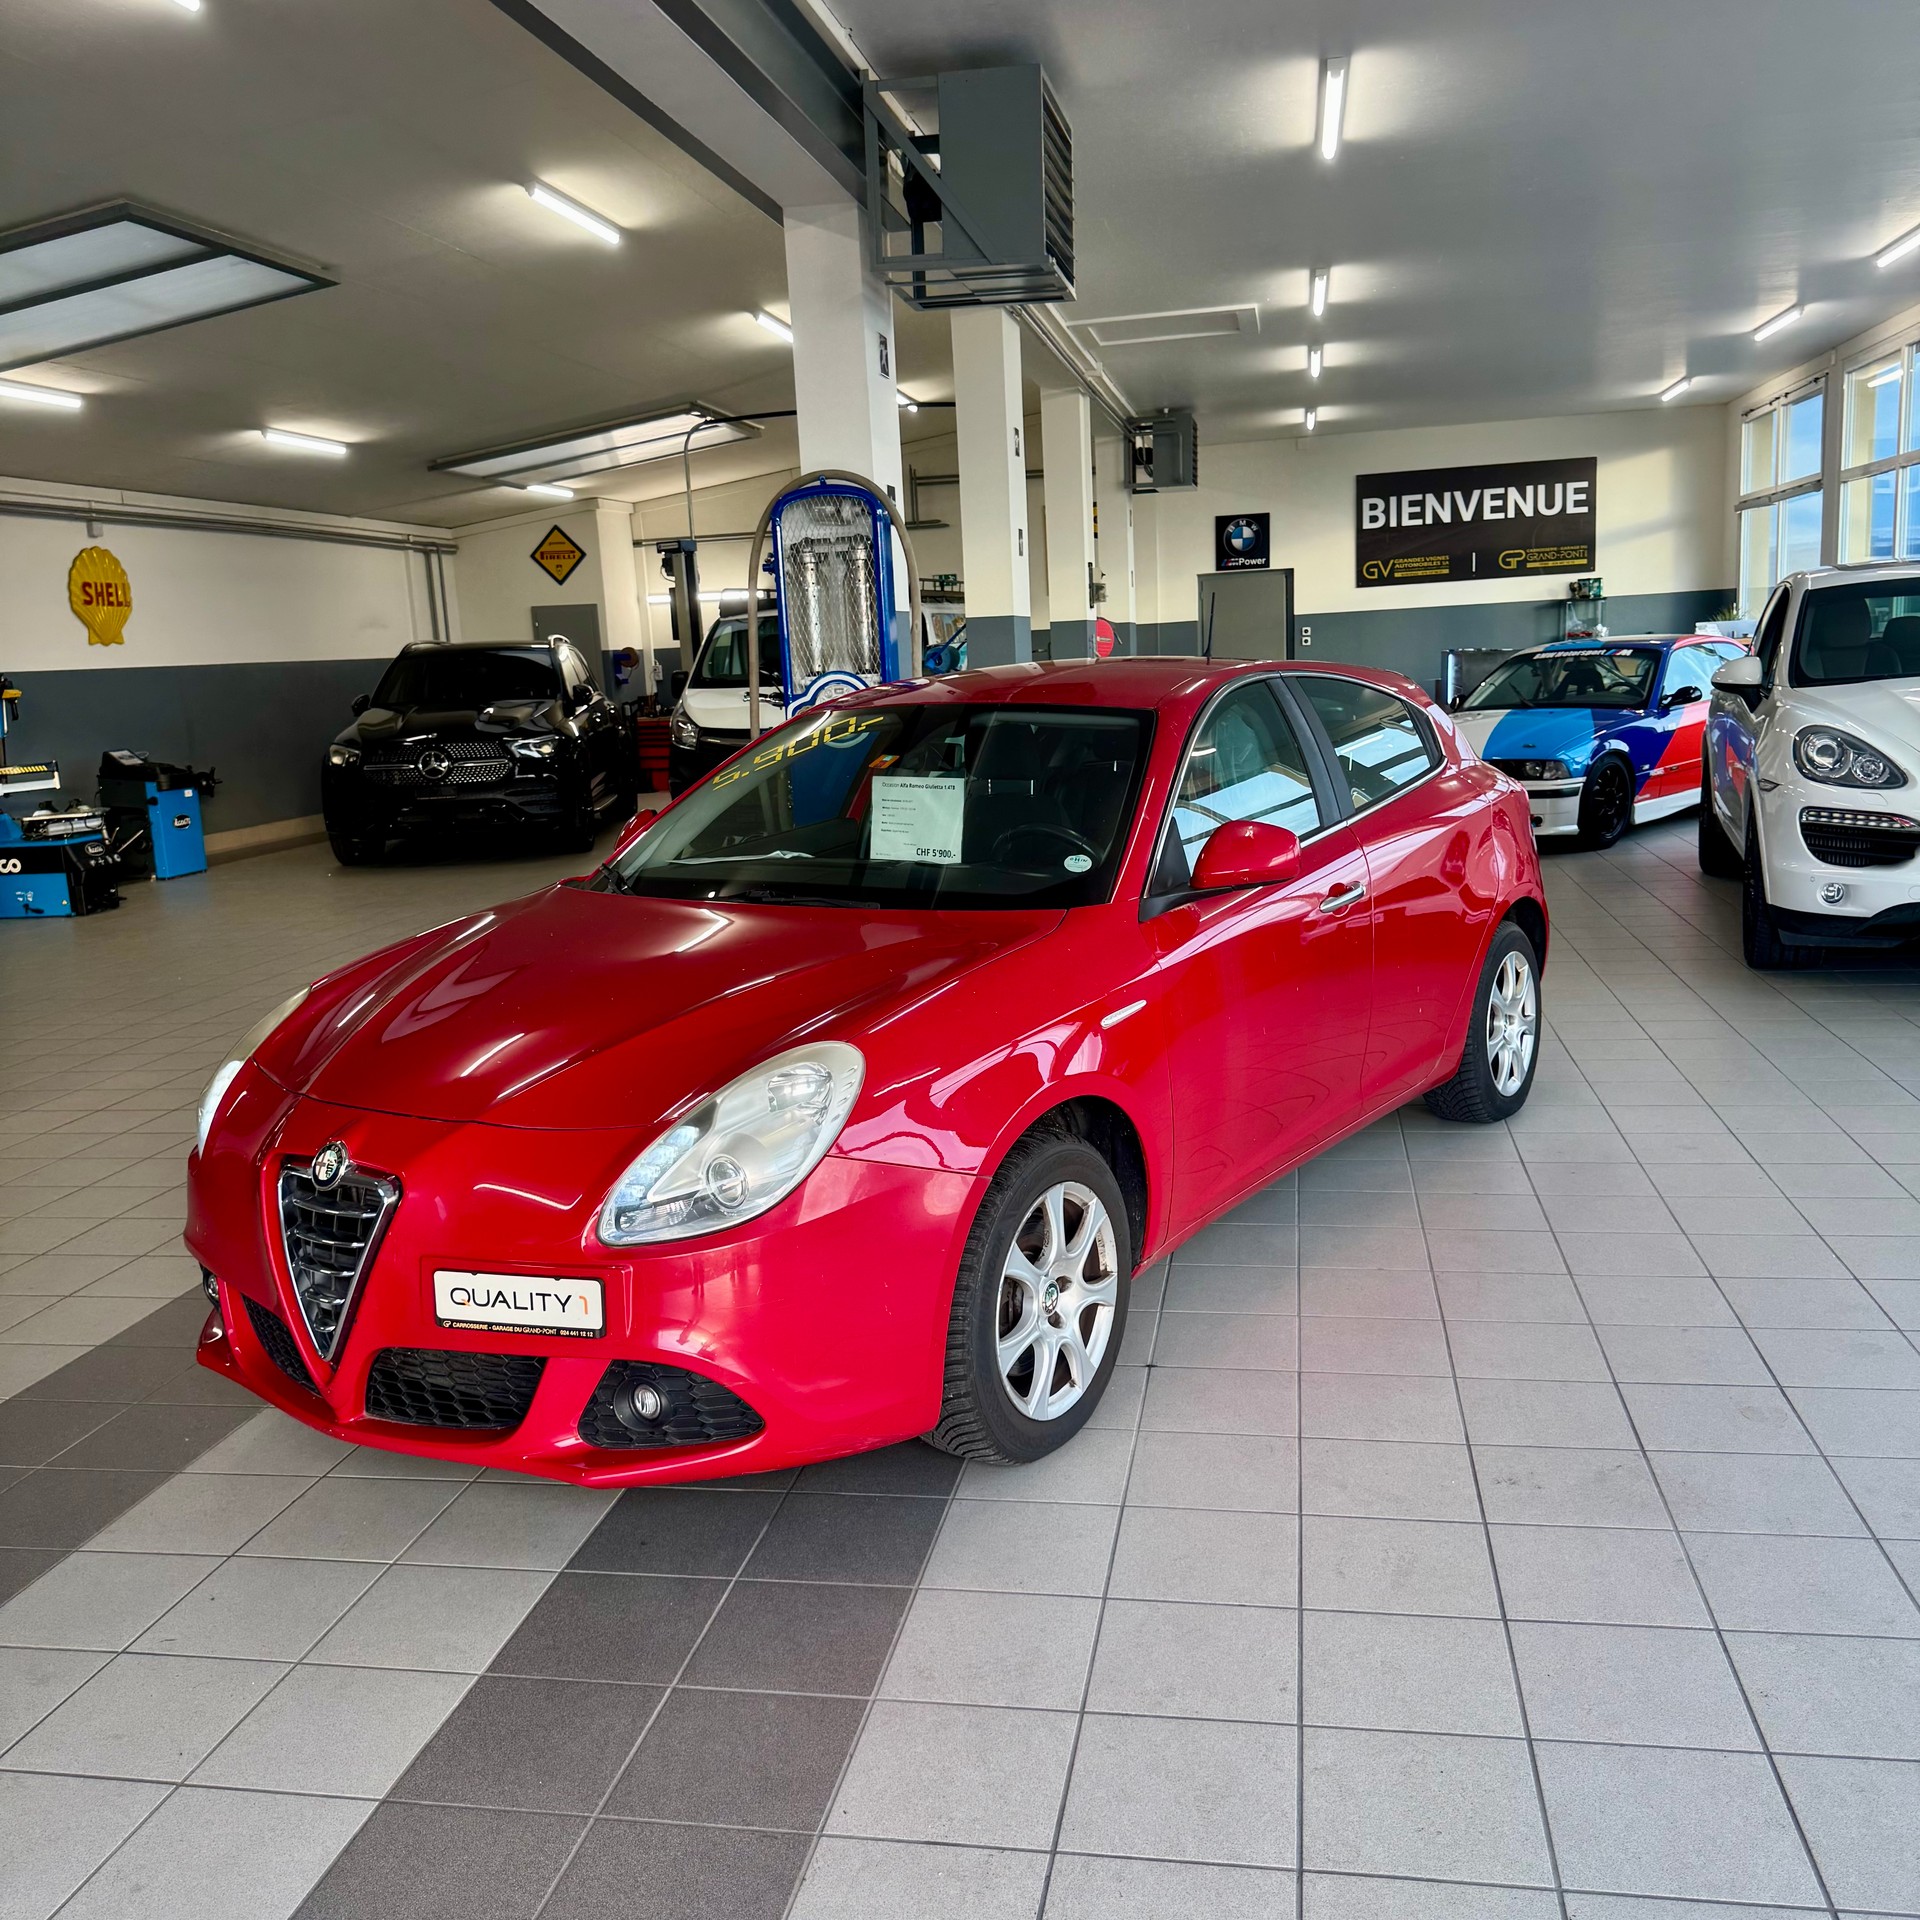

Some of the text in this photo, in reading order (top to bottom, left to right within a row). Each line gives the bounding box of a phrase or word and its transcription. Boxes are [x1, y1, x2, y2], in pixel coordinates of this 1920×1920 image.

[1362, 481, 1589, 530] BIENVENUE
[540, 550, 576, 560] PIRELLI
[1526, 549, 1585, 561] GRAND-PONT
[1239, 557, 1267, 567] Power
[1362, 560, 1394, 579] GV
[81, 581, 131, 608] SHELL
[1555, 649, 1606, 658] Motorsport
[916, 847, 957, 859] CHF 5'900.-
[450, 1287, 589, 1315] QUALITY 1
[452, 1321, 489, 1331] CARROSSERIE
[492, 1325, 514, 1333] GARAGE
[523, 1327, 557, 1335] GRAND-PONT
